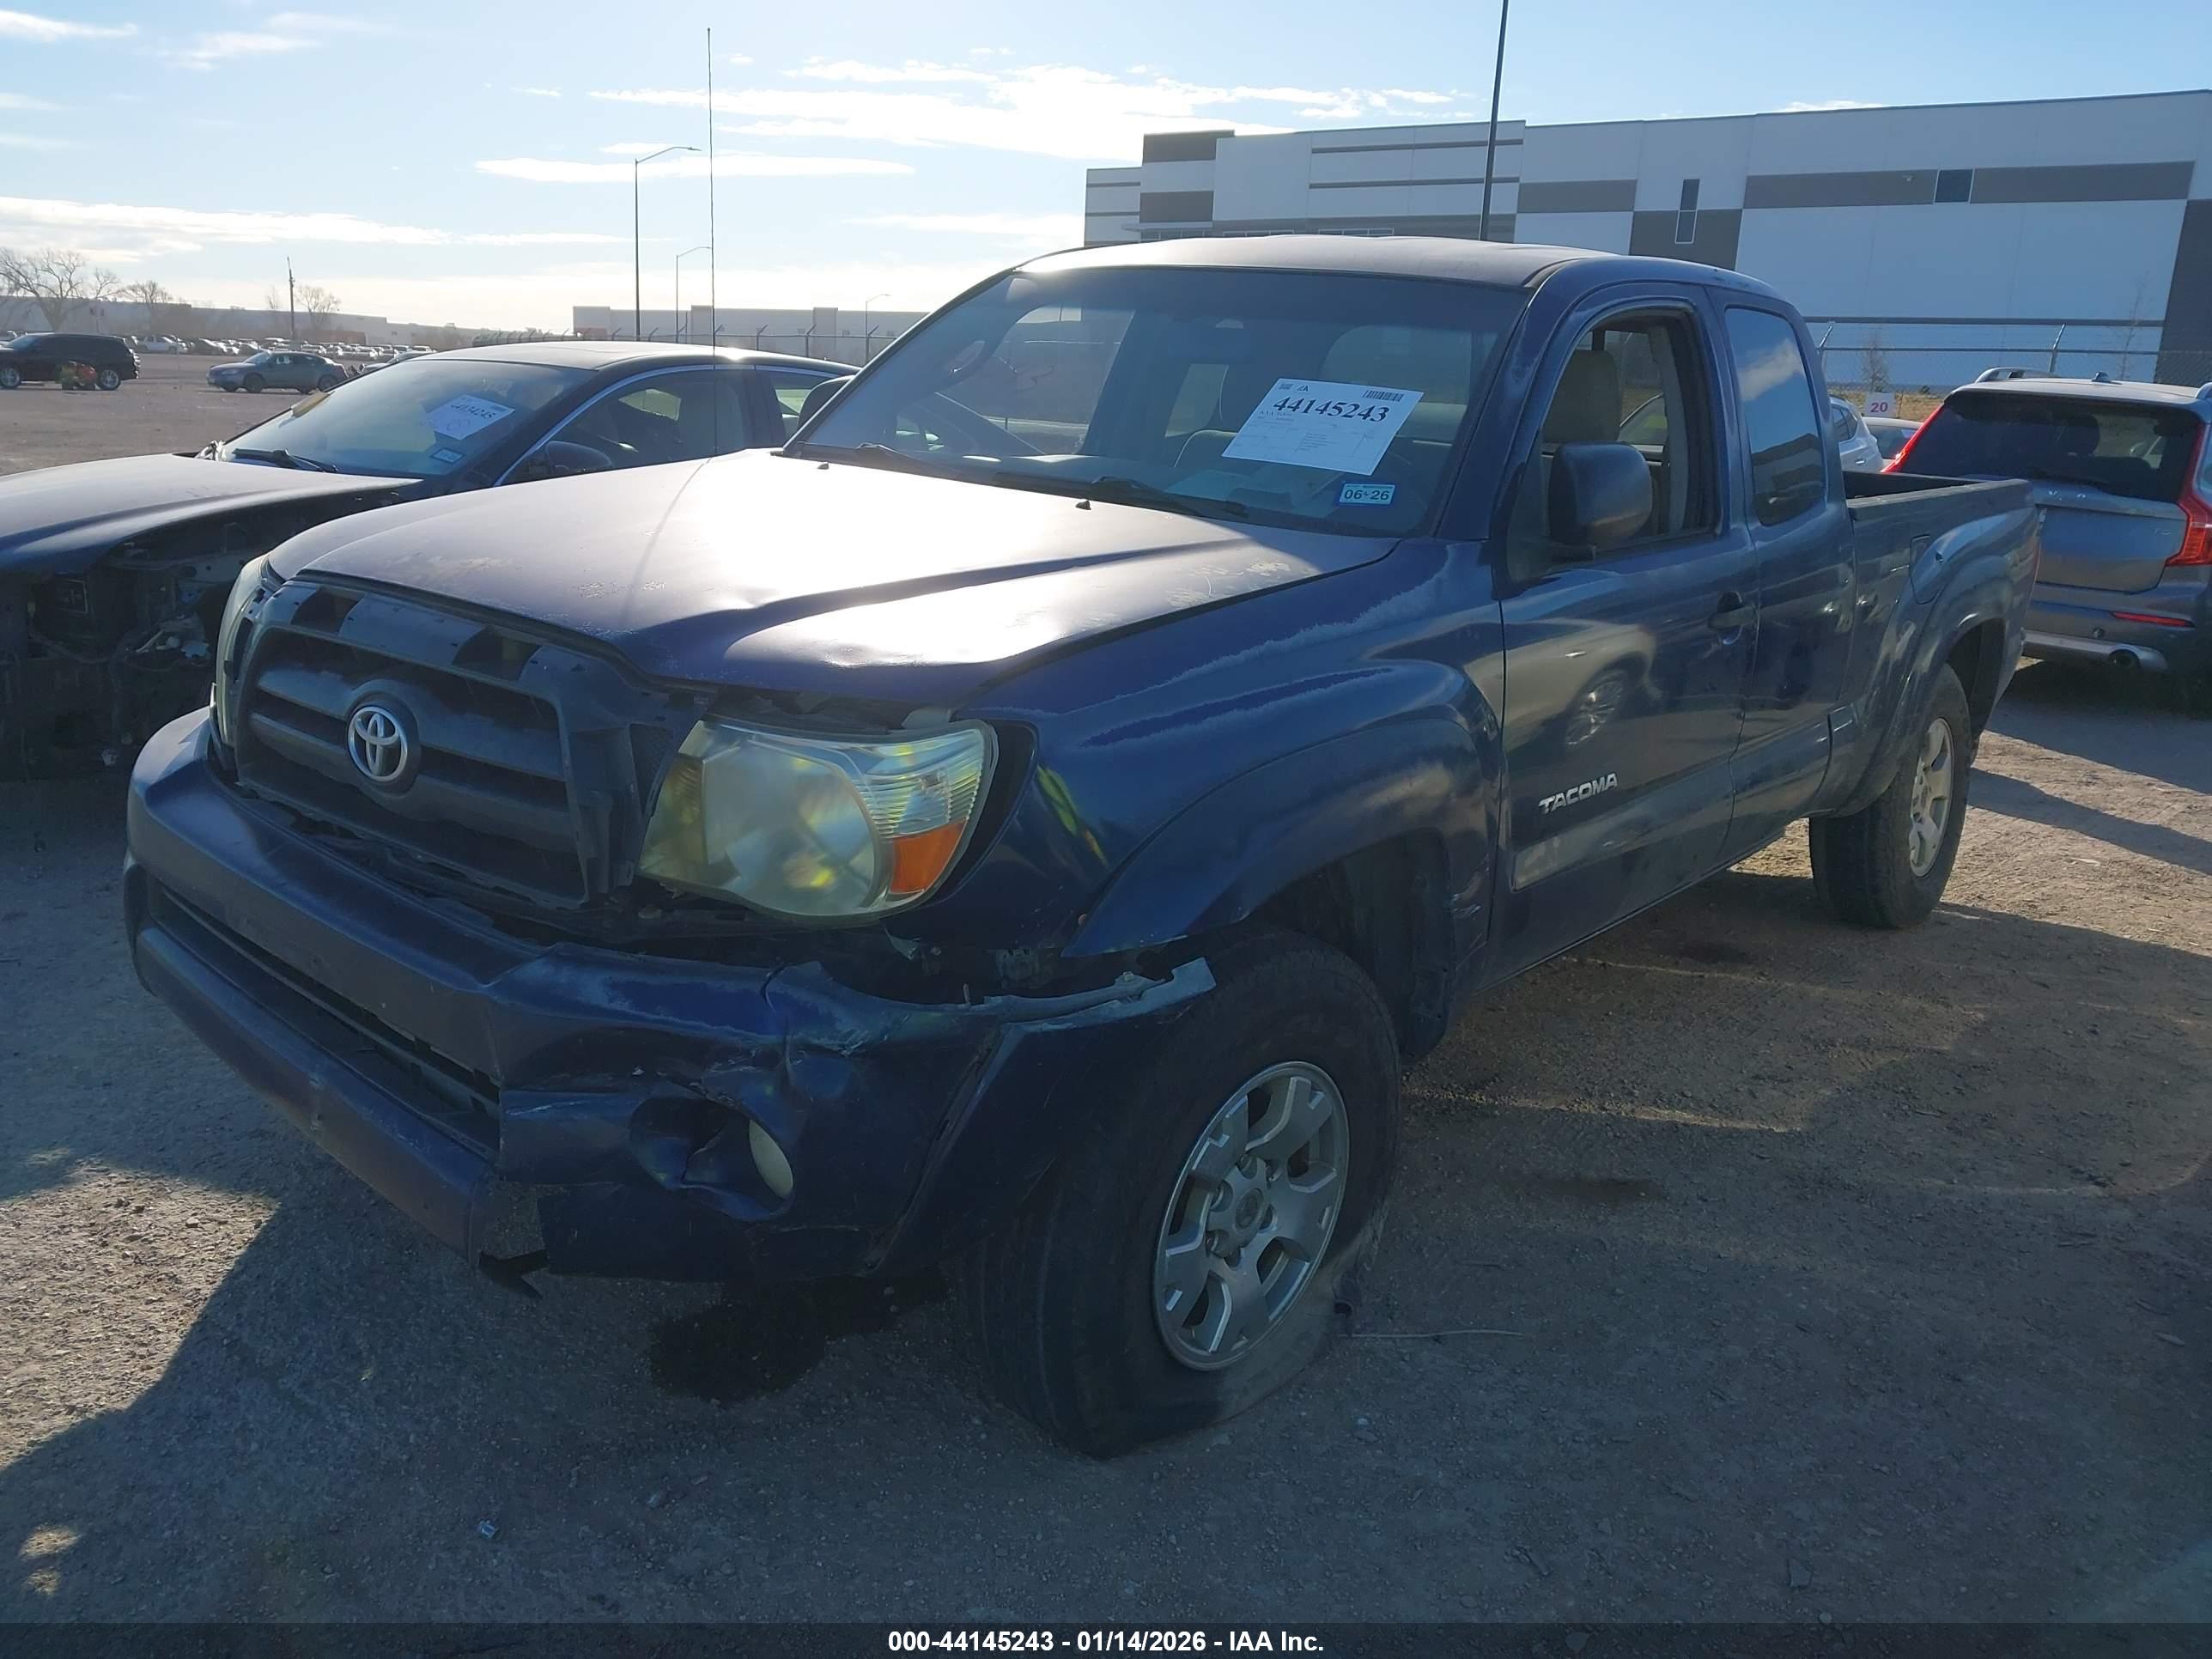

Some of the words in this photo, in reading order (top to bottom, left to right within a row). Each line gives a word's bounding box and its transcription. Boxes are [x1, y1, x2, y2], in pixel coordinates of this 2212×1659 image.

[1273, 397, 1389, 422] 44145243
[1871, 402, 1887, 412] 20
[1345, 489, 1363, 500] 06
[1370, 489, 1390, 501] 26
[1539, 774, 1618, 813] TACOMA
